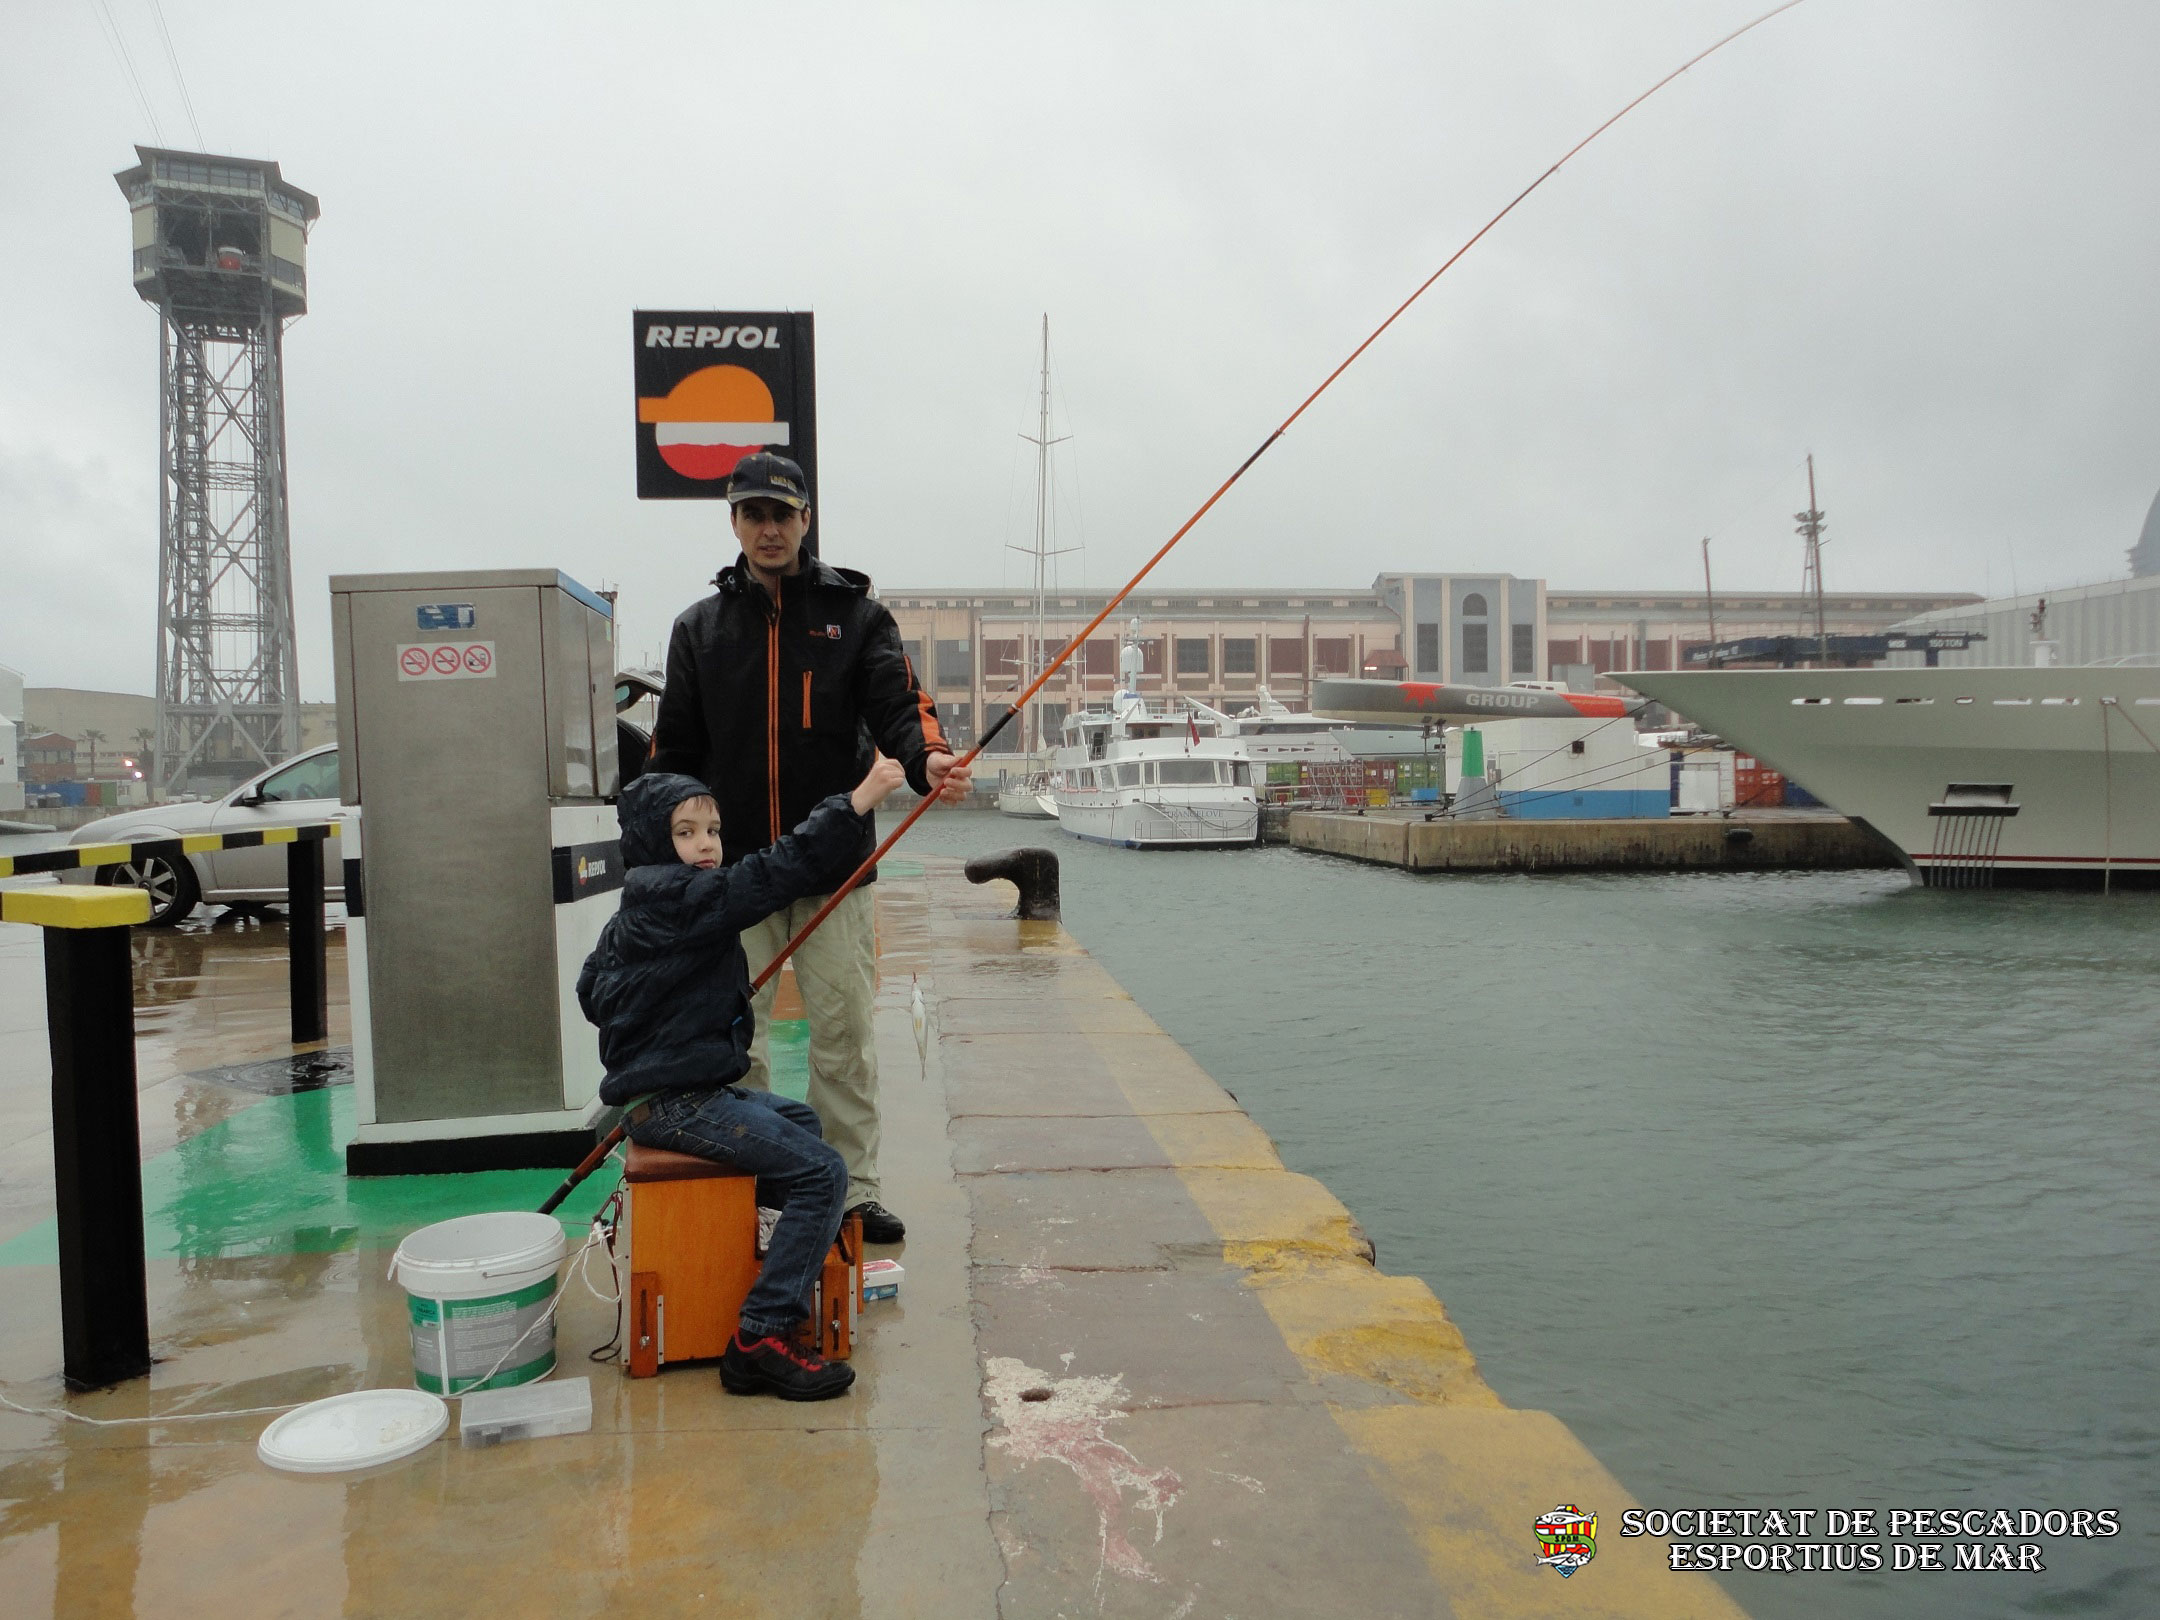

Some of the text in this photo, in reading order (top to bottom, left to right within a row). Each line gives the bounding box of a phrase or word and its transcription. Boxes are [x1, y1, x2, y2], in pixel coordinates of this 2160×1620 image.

[645, 324, 781, 349] REPSOL
[1465, 693, 1539, 708] GROUP
[588, 859, 606, 878] REPSOL
